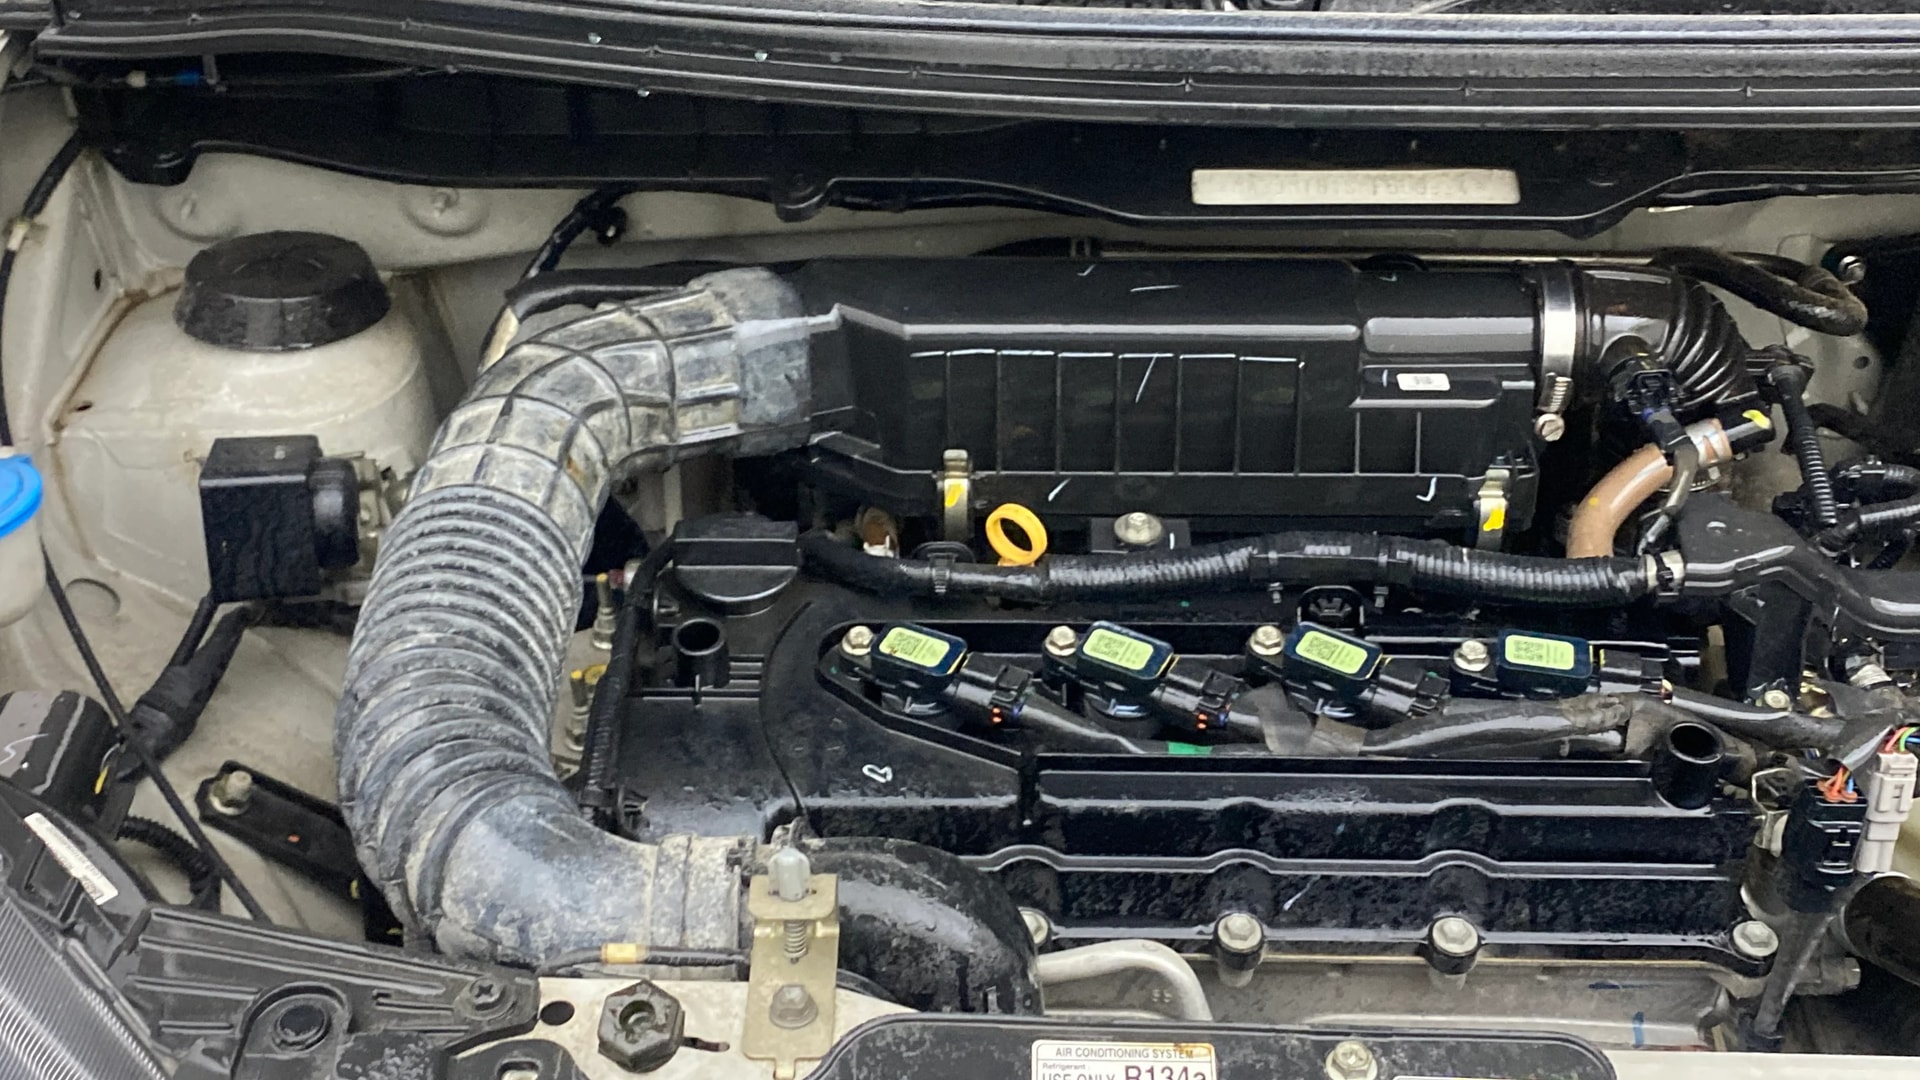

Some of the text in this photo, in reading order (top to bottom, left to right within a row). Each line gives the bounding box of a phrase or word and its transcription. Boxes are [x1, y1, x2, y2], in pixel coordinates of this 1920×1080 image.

[1056, 1047, 1194, 1060] AIR CONDITIONING SYSTEM
